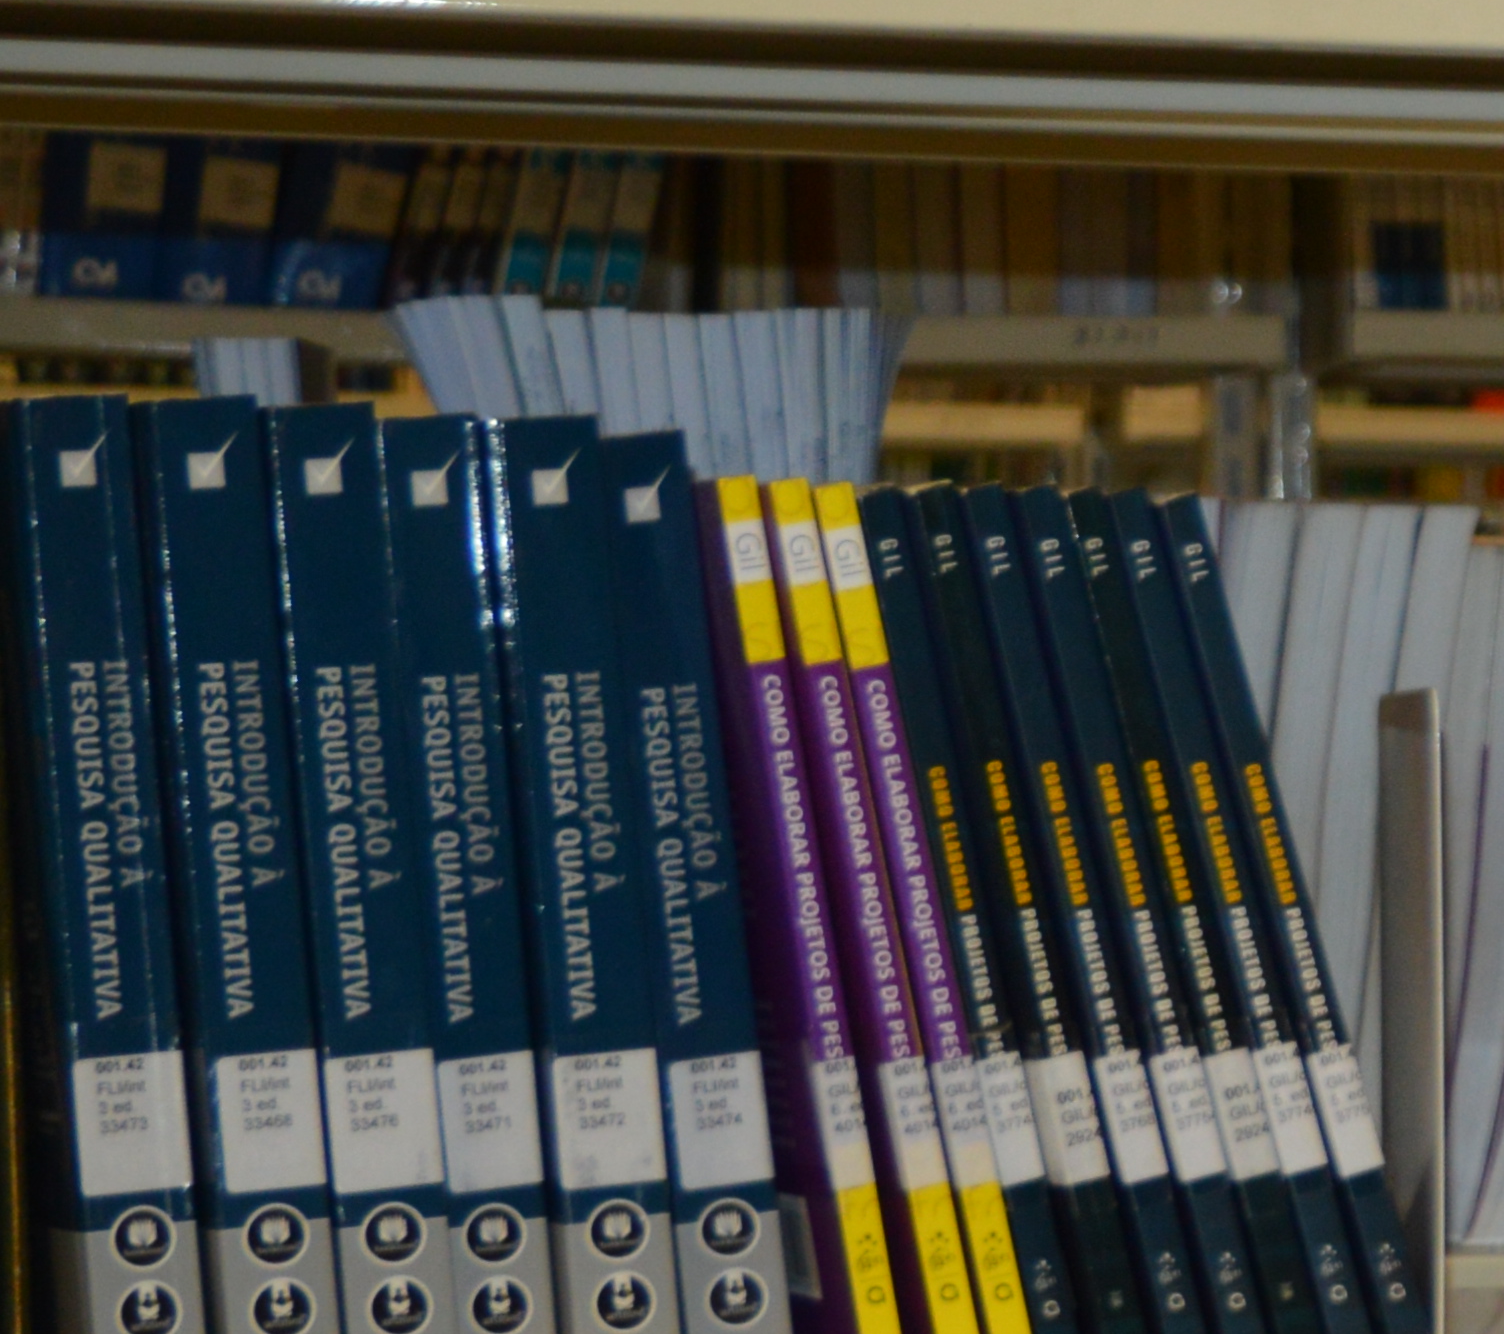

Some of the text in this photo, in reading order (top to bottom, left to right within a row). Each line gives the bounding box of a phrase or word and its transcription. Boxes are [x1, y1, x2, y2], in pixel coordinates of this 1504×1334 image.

[734, 532, 766, 573] Gil
[788, 533, 820, 574] Gil
[879, 537, 903, 580] GIL
[1130, 539, 1156, 582] GIL
[1184, 542, 1209, 583] GIL
[70, 662, 123, 1020] PESQUISA QUALITATIVA
[103, 660, 153, 888] INTRODUÇÃO À
[422, 675, 475, 1025] PESQUISA QUALITATIVA
[455, 673, 503, 896] INTRODUÇÃO À
[640, 687, 703, 1026] PESQUISA QUALITATIVA
[672, 683, 727, 900] INTRODUÇÃO À
[762, 673, 837, 1016] COMO ELABORAR PROJETOS DE
[868, 679, 953, 1017] COMO ELABORAR PROJETOS DE
[986, 760, 1060, 1020] COMO ELABORAR PROJETOS DE
